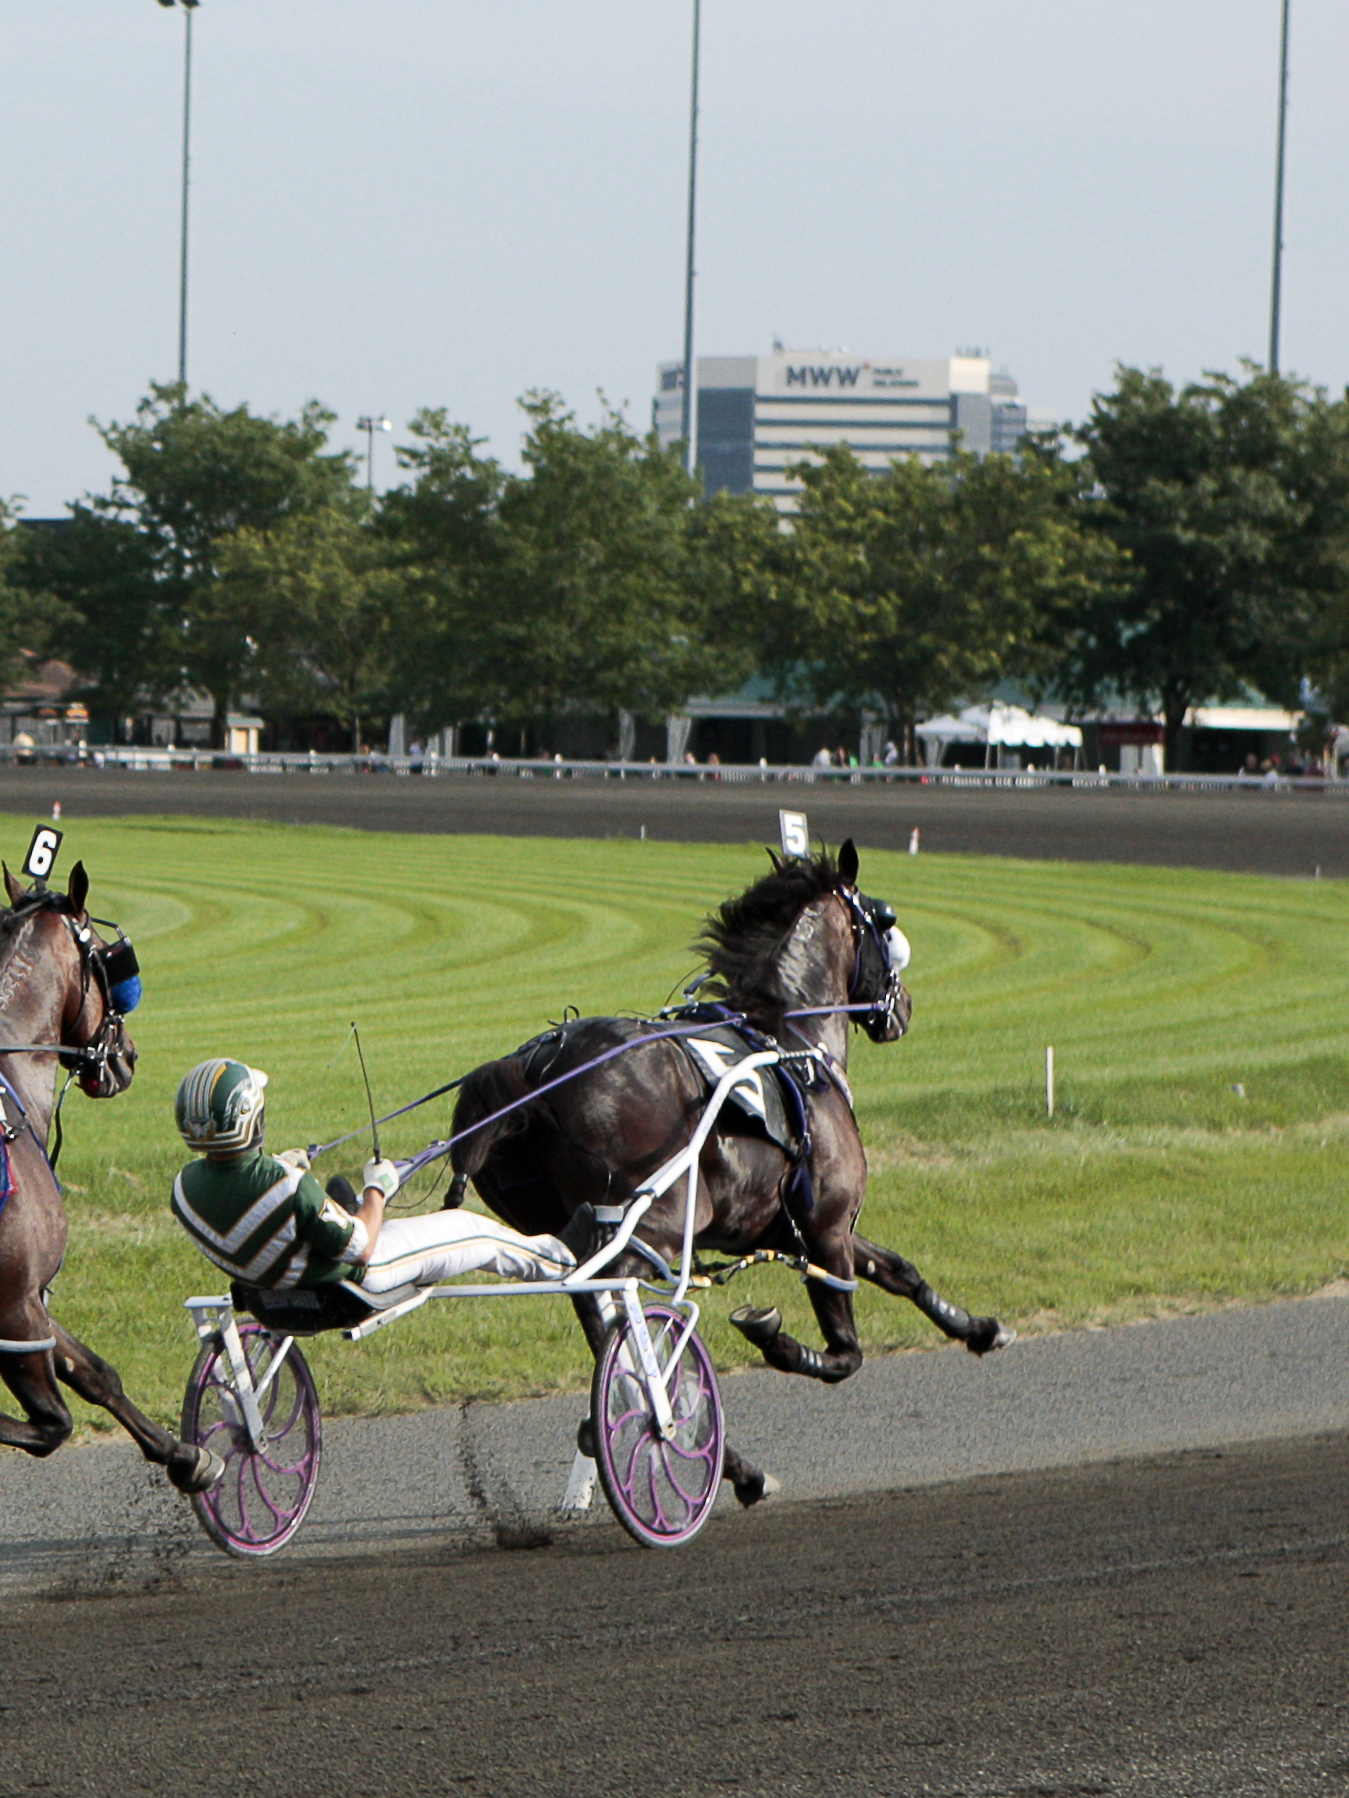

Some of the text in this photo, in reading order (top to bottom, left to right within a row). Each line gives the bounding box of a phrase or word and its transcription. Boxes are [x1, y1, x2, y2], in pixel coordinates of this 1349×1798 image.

[786, 365, 862, 387] MWW
[28, 830, 57, 876] 6
[783, 812, 807, 856] 5
